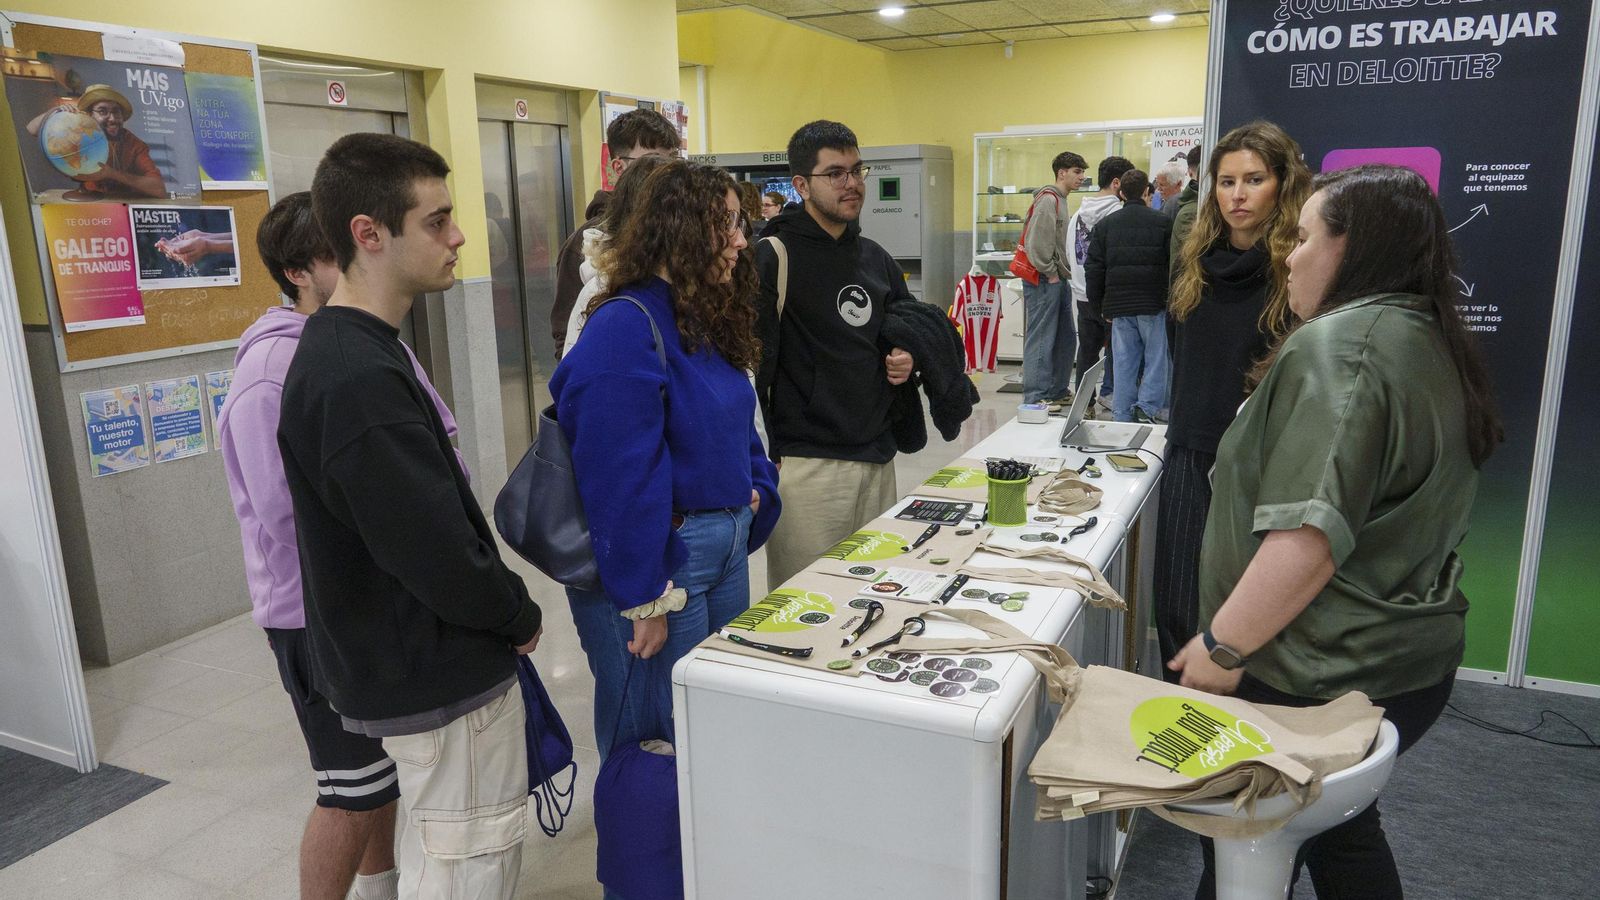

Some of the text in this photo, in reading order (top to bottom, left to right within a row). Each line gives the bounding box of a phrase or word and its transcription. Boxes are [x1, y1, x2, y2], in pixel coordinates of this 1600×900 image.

[1247, 11, 1558, 54] CÓMO ES TRABAJAR
[1289, 52, 1502, 88] EN DELOITTE?
[139, 89, 185, 112] UVigo
[200, 119, 224, 129] ZONA
[201, 130, 213, 138] DE
[1154, 128, 1179, 137] WANT
[1180, 128, 1187, 136] A
[1154, 138, 1203, 148] IN TECH O
[1465, 162, 1531, 171] Para conocer
[1468, 172, 1525, 183] al equipazo
[1463, 184, 1528, 193] que tenemos
[54, 237, 129, 259] GALEGO
[58, 263, 73, 275] DE
[75, 260, 131, 274] TRANQUIS
[1489, 304, 1498, 312] lo
[1464, 315, 1482, 323] que
[90, 418, 139, 434] Tu talento,
[98, 428, 134, 442] nuestro
[104, 438, 132, 450] motor
[1199, 719, 1272, 769] Choose
[1135, 727, 1208, 774] impact
